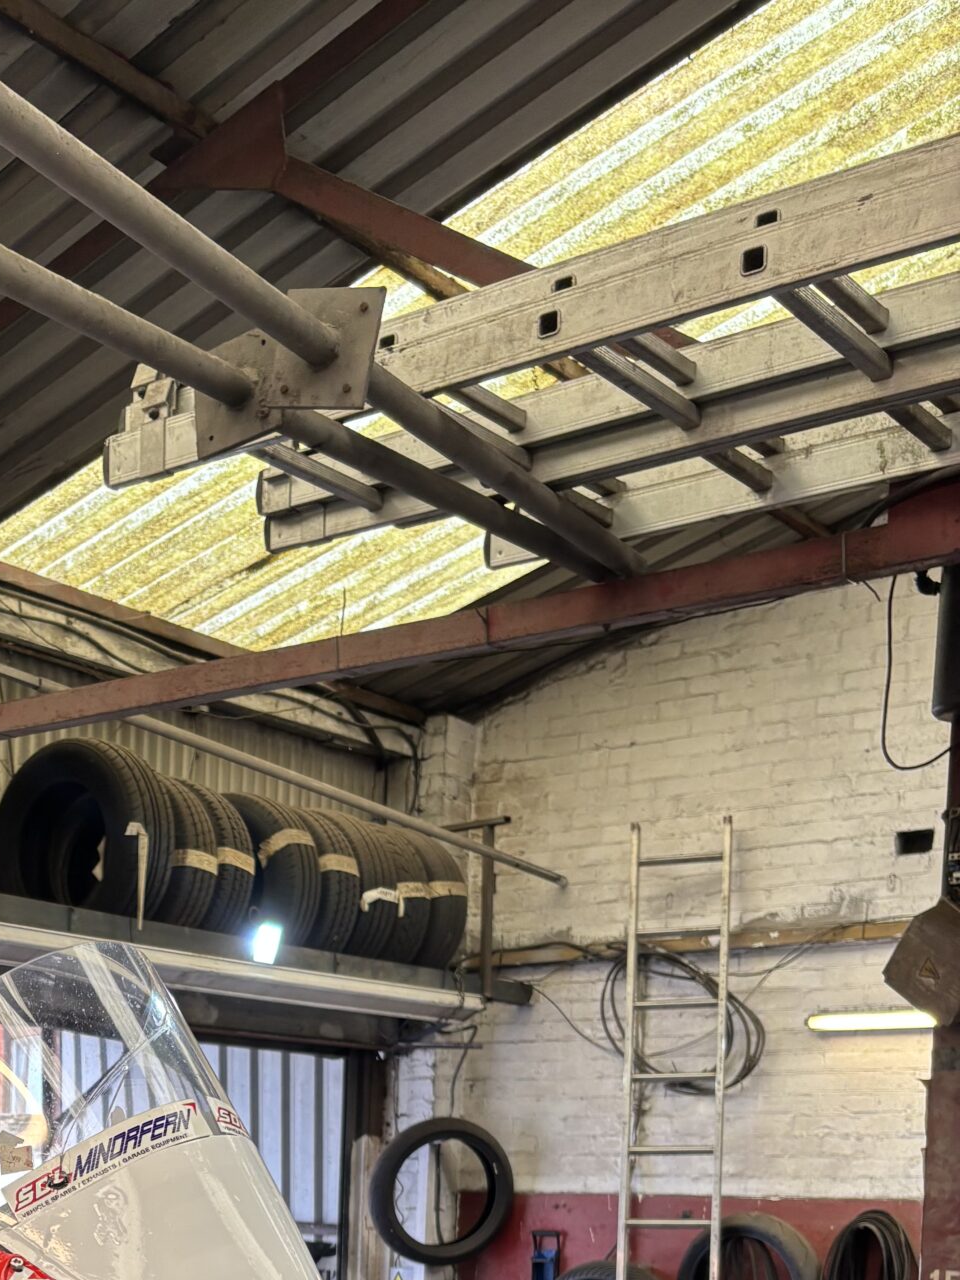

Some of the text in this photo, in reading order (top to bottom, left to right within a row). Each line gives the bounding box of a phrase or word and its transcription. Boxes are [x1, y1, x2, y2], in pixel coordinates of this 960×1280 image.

[82, 1164, 117, 1185] EXHAUSTS
[122, 1147, 151, 1163] GARAGE
[151, 1133, 188, 1151] EQUIPMENT
